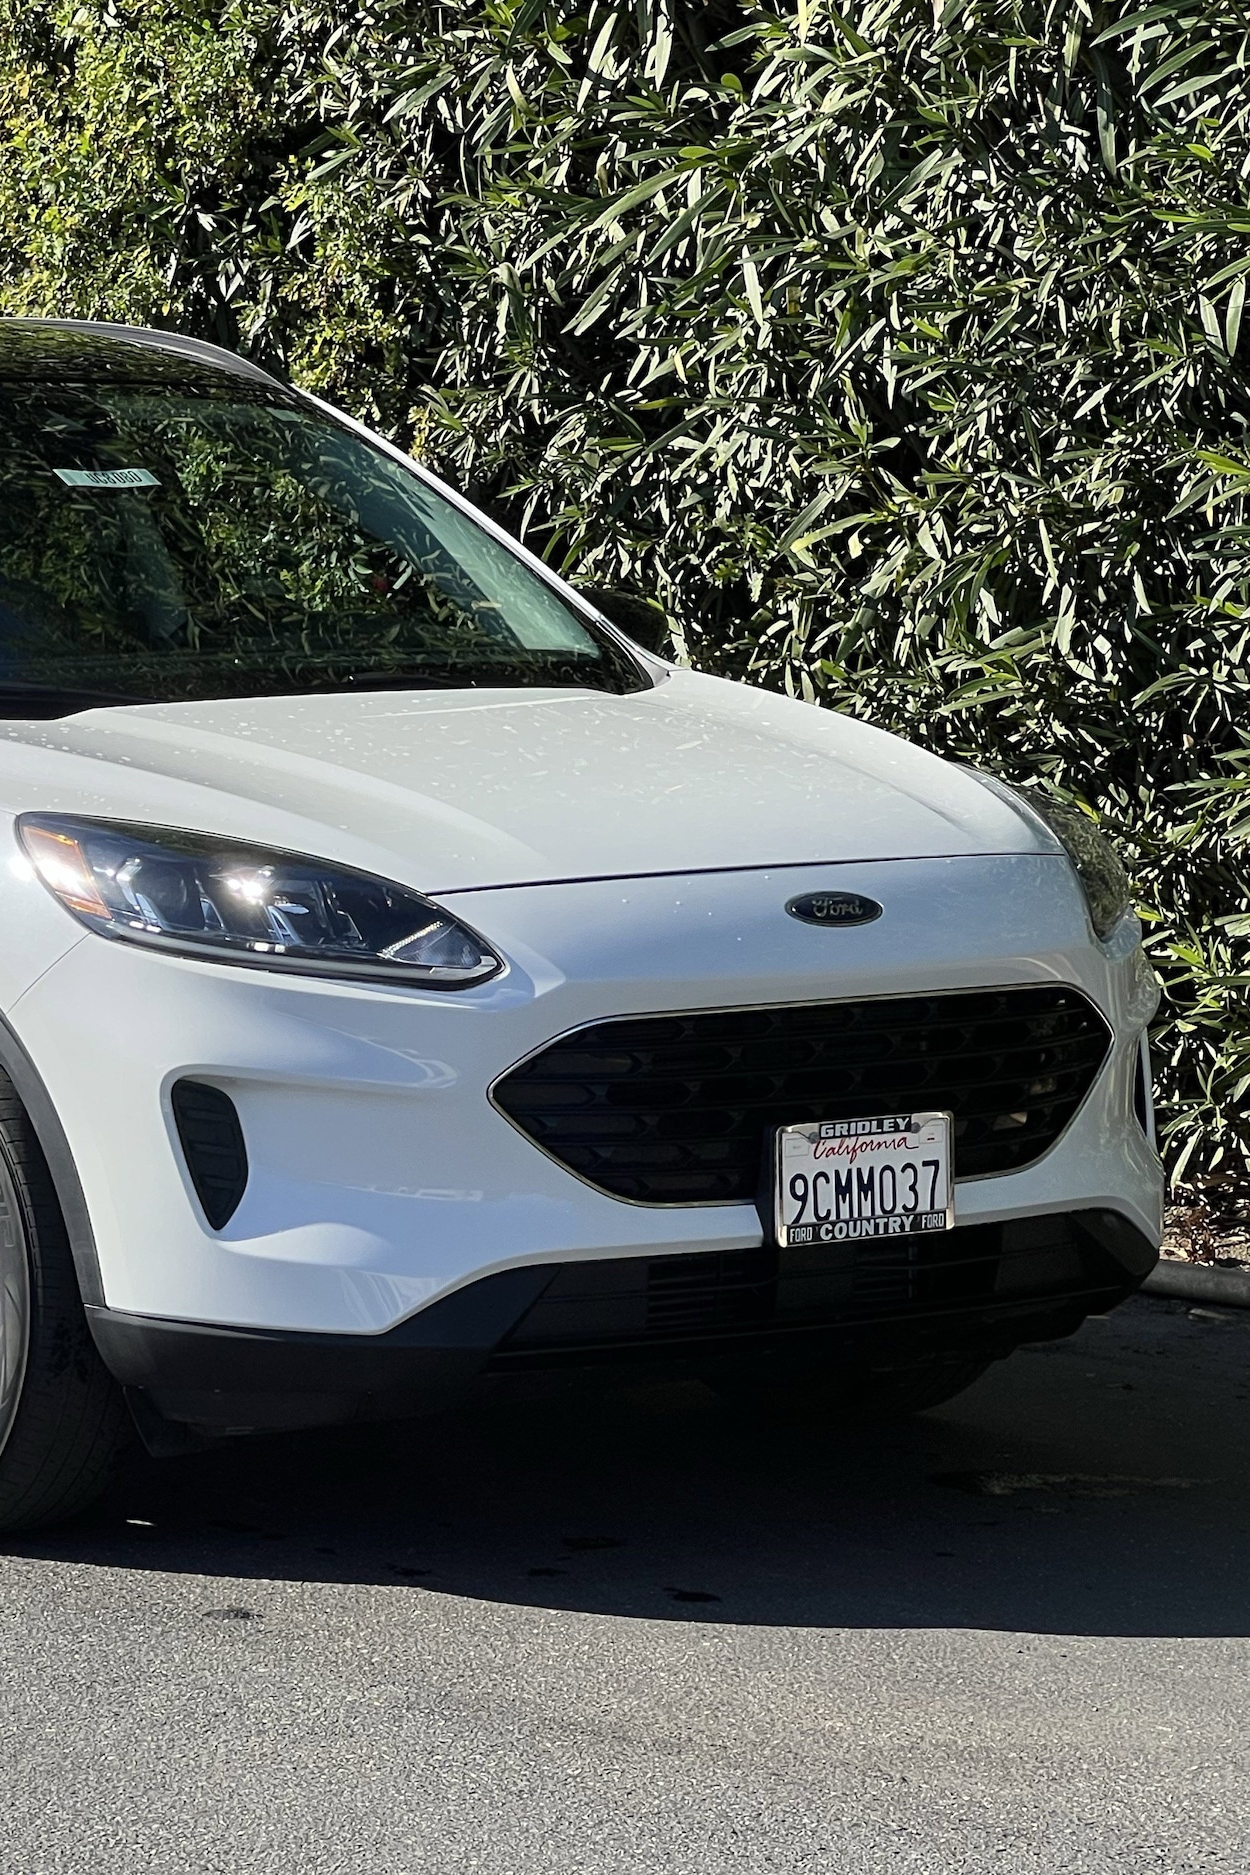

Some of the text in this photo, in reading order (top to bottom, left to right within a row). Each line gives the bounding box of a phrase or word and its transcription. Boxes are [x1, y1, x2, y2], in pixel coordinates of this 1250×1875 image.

[812, 897, 864, 918] Ford
[820, 1117, 911, 1138] GRIDLEY
[813, 1136, 920, 1165] California
[789, 1159, 940, 1225] 9CMM037
[789, 1213, 945, 1243] FORD COUNTRY FORD
